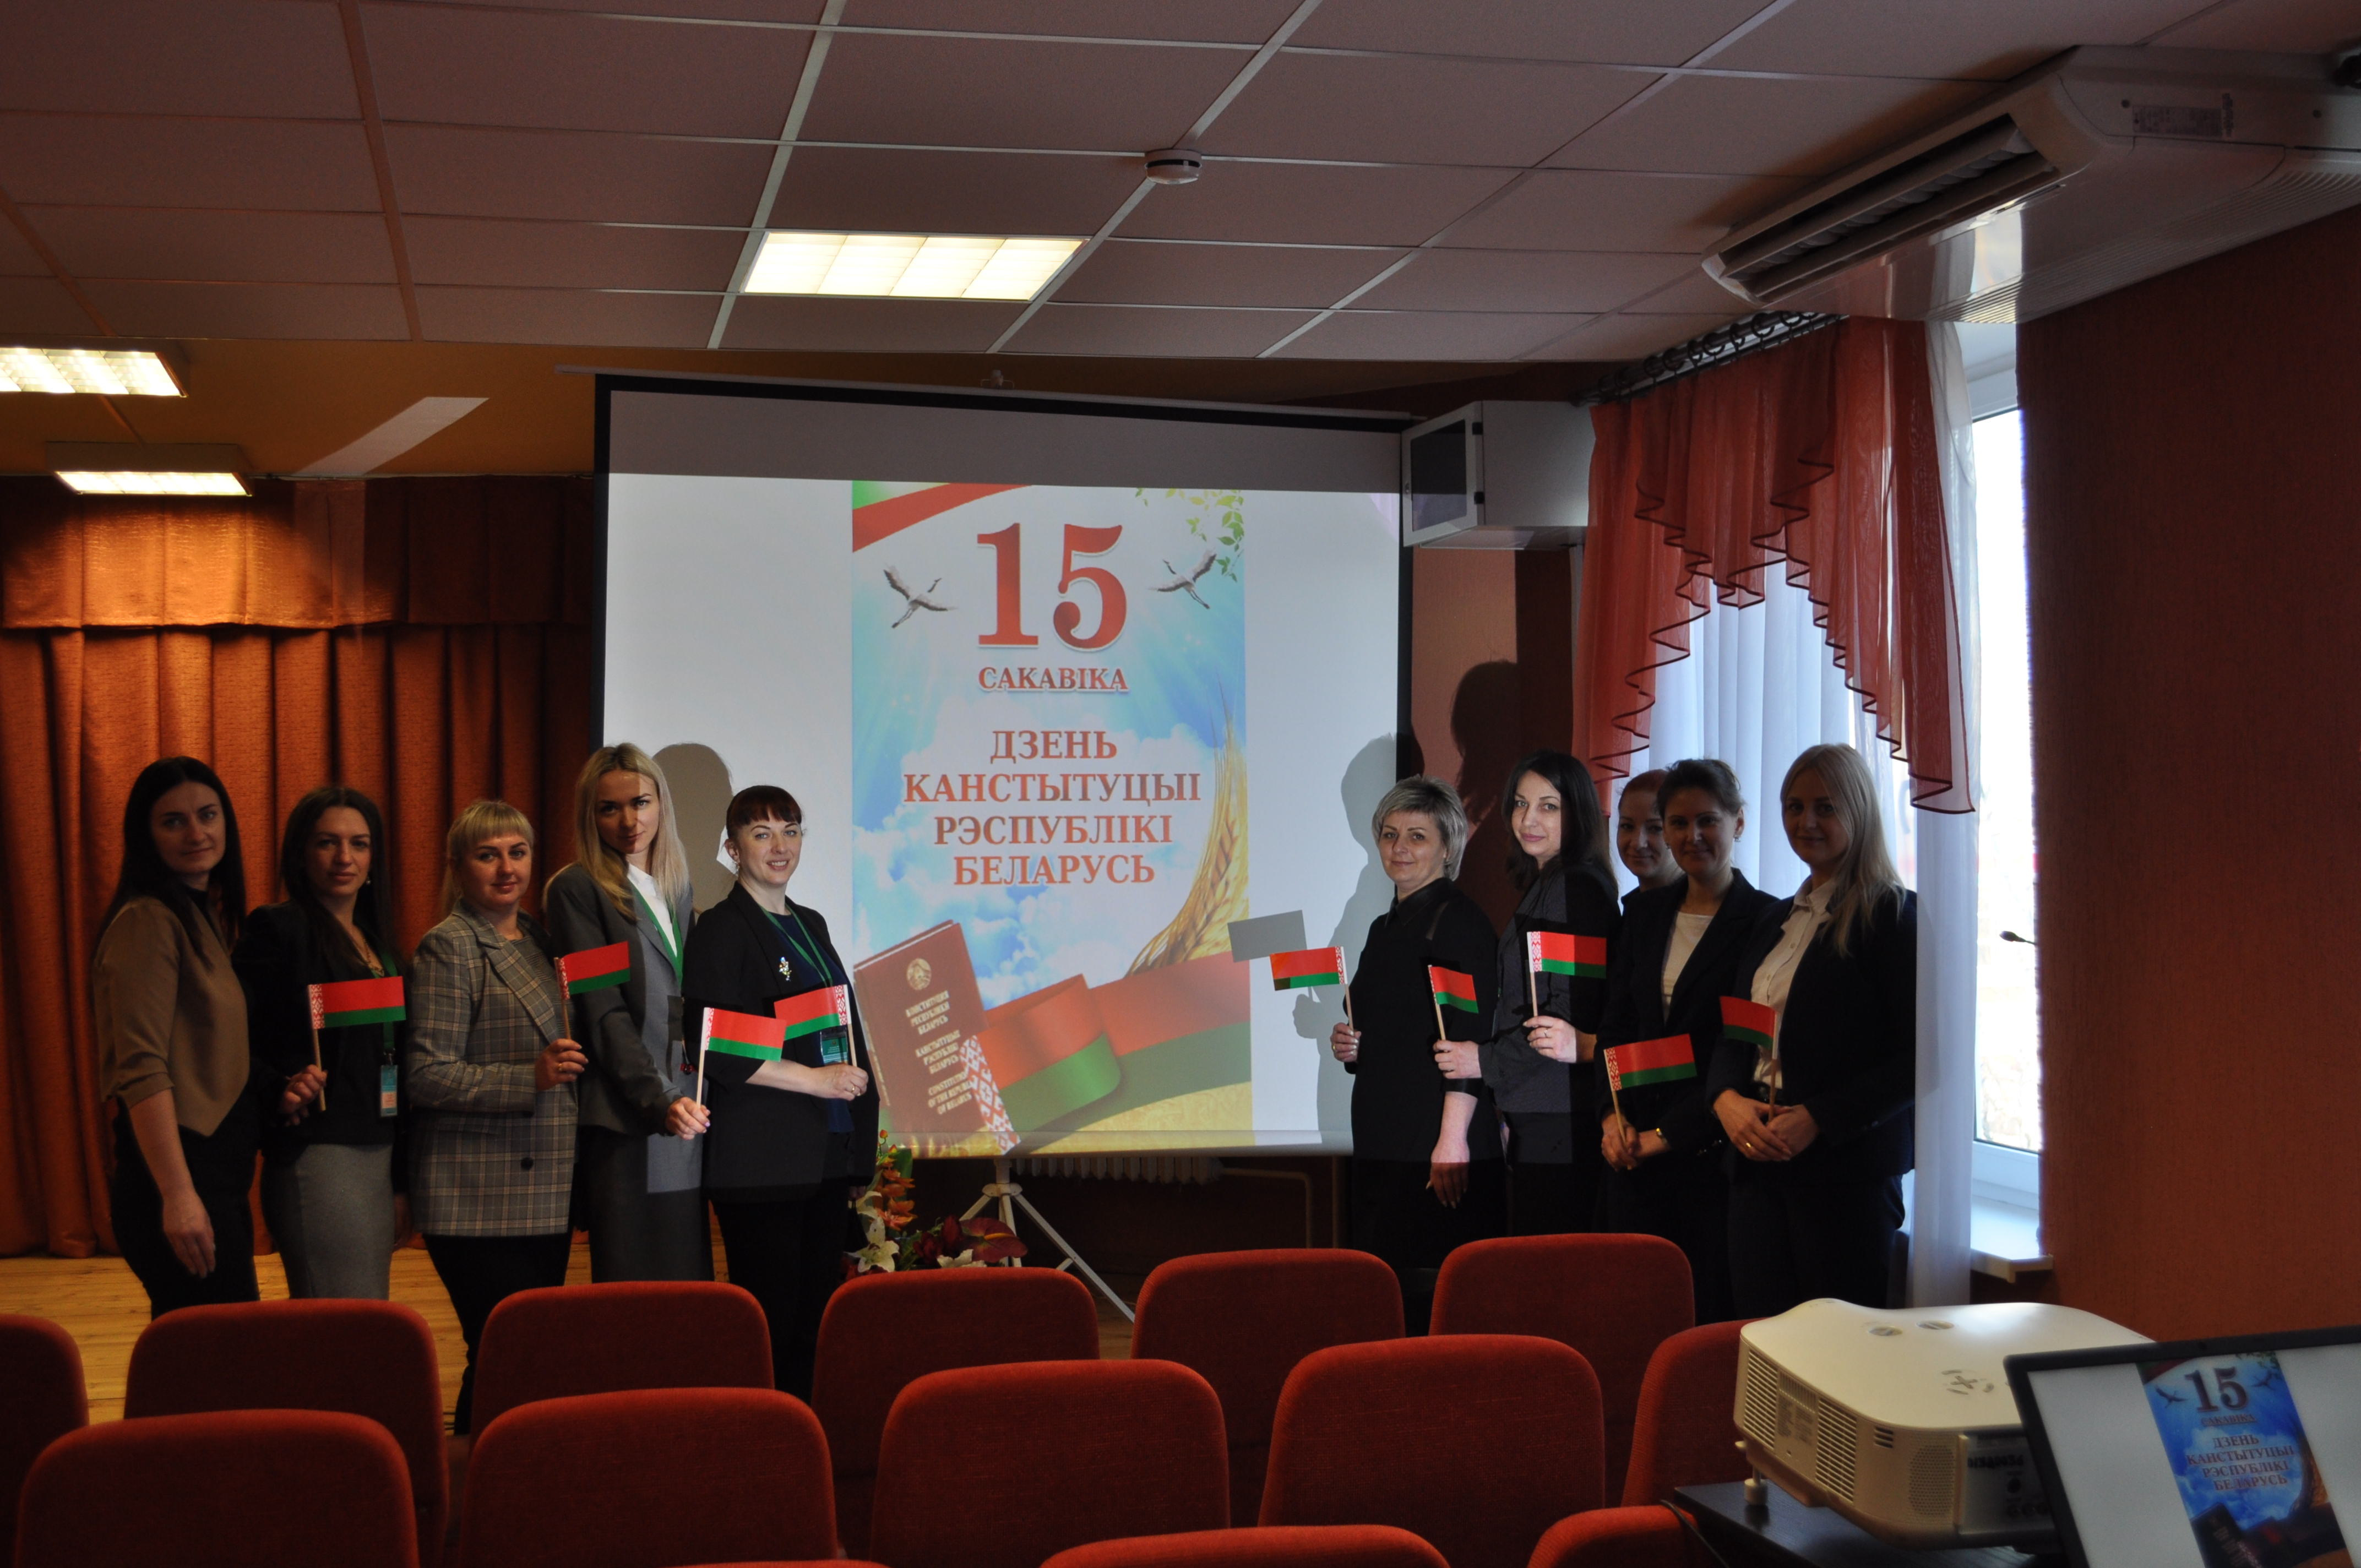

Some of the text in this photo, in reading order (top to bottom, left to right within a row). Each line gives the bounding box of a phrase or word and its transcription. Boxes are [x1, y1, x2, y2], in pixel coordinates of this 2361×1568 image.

[977, 522, 1128, 650] 15
[978, 666, 1129, 690] САКАВІКА
[989, 730, 1118, 764] ДЗЕНЬ
[903, 772, 1201, 807] КАНСТЫТУЦЫІ
[934, 815, 1173, 845] РЭСПУБЛІКІ
[953, 854, 1156, 886] БЕЛАРУСЬ
[2184, 1366, 2248, 1413] 15
[2201, 1413, 2257, 1427] САКАВІКА
[2212, 1434, 2260, 1449] ДЗЕНЬ
[2185, 1445, 2296, 1466] КАНСТЫТУЦЫІ
[2202, 1460, 2289, 1478] РЭСПУБЛІКІ
[2213, 1474, 2288, 1491] БЕЛАРУСЬ
